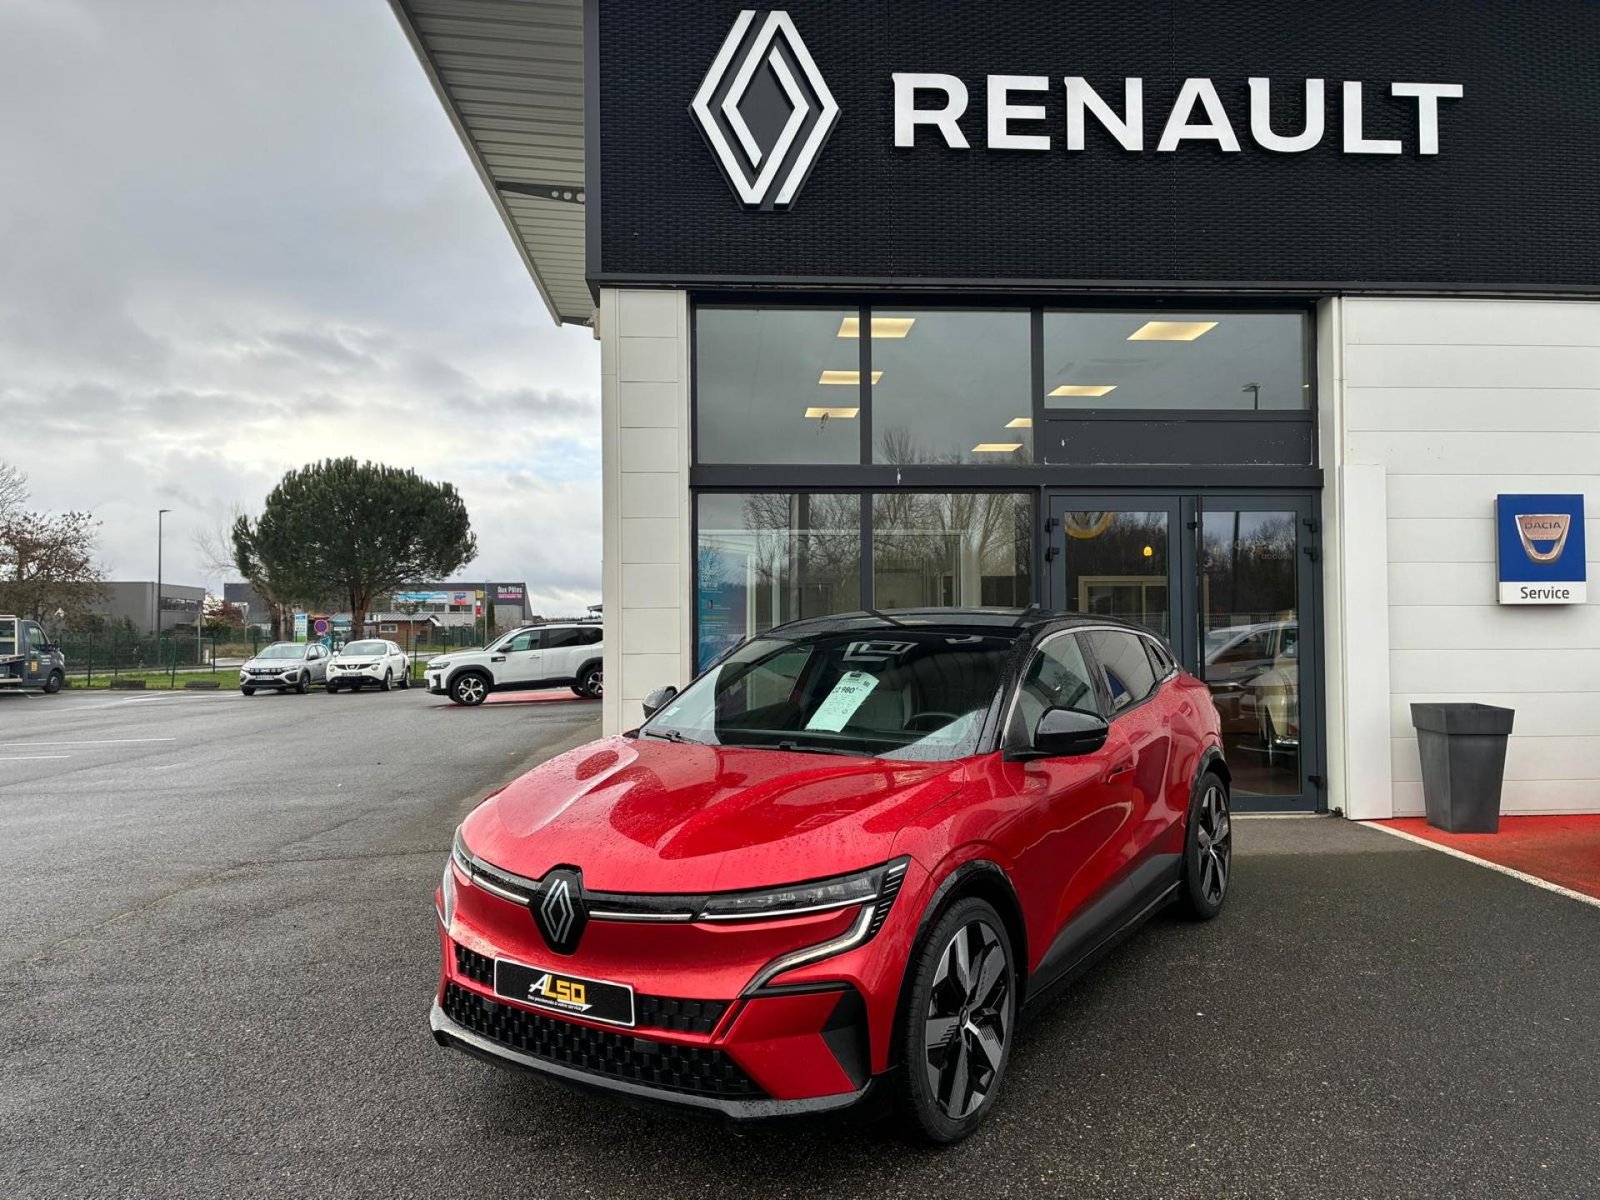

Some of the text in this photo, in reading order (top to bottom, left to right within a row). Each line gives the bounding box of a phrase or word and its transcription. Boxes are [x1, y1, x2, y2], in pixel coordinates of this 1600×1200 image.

[891, 72, 1465, 155] RENAULT
[1524, 521, 1562, 530] DACIA
[1520, 586, 1570, 600] Service
[528, 974, 585, 1004] ALSO
